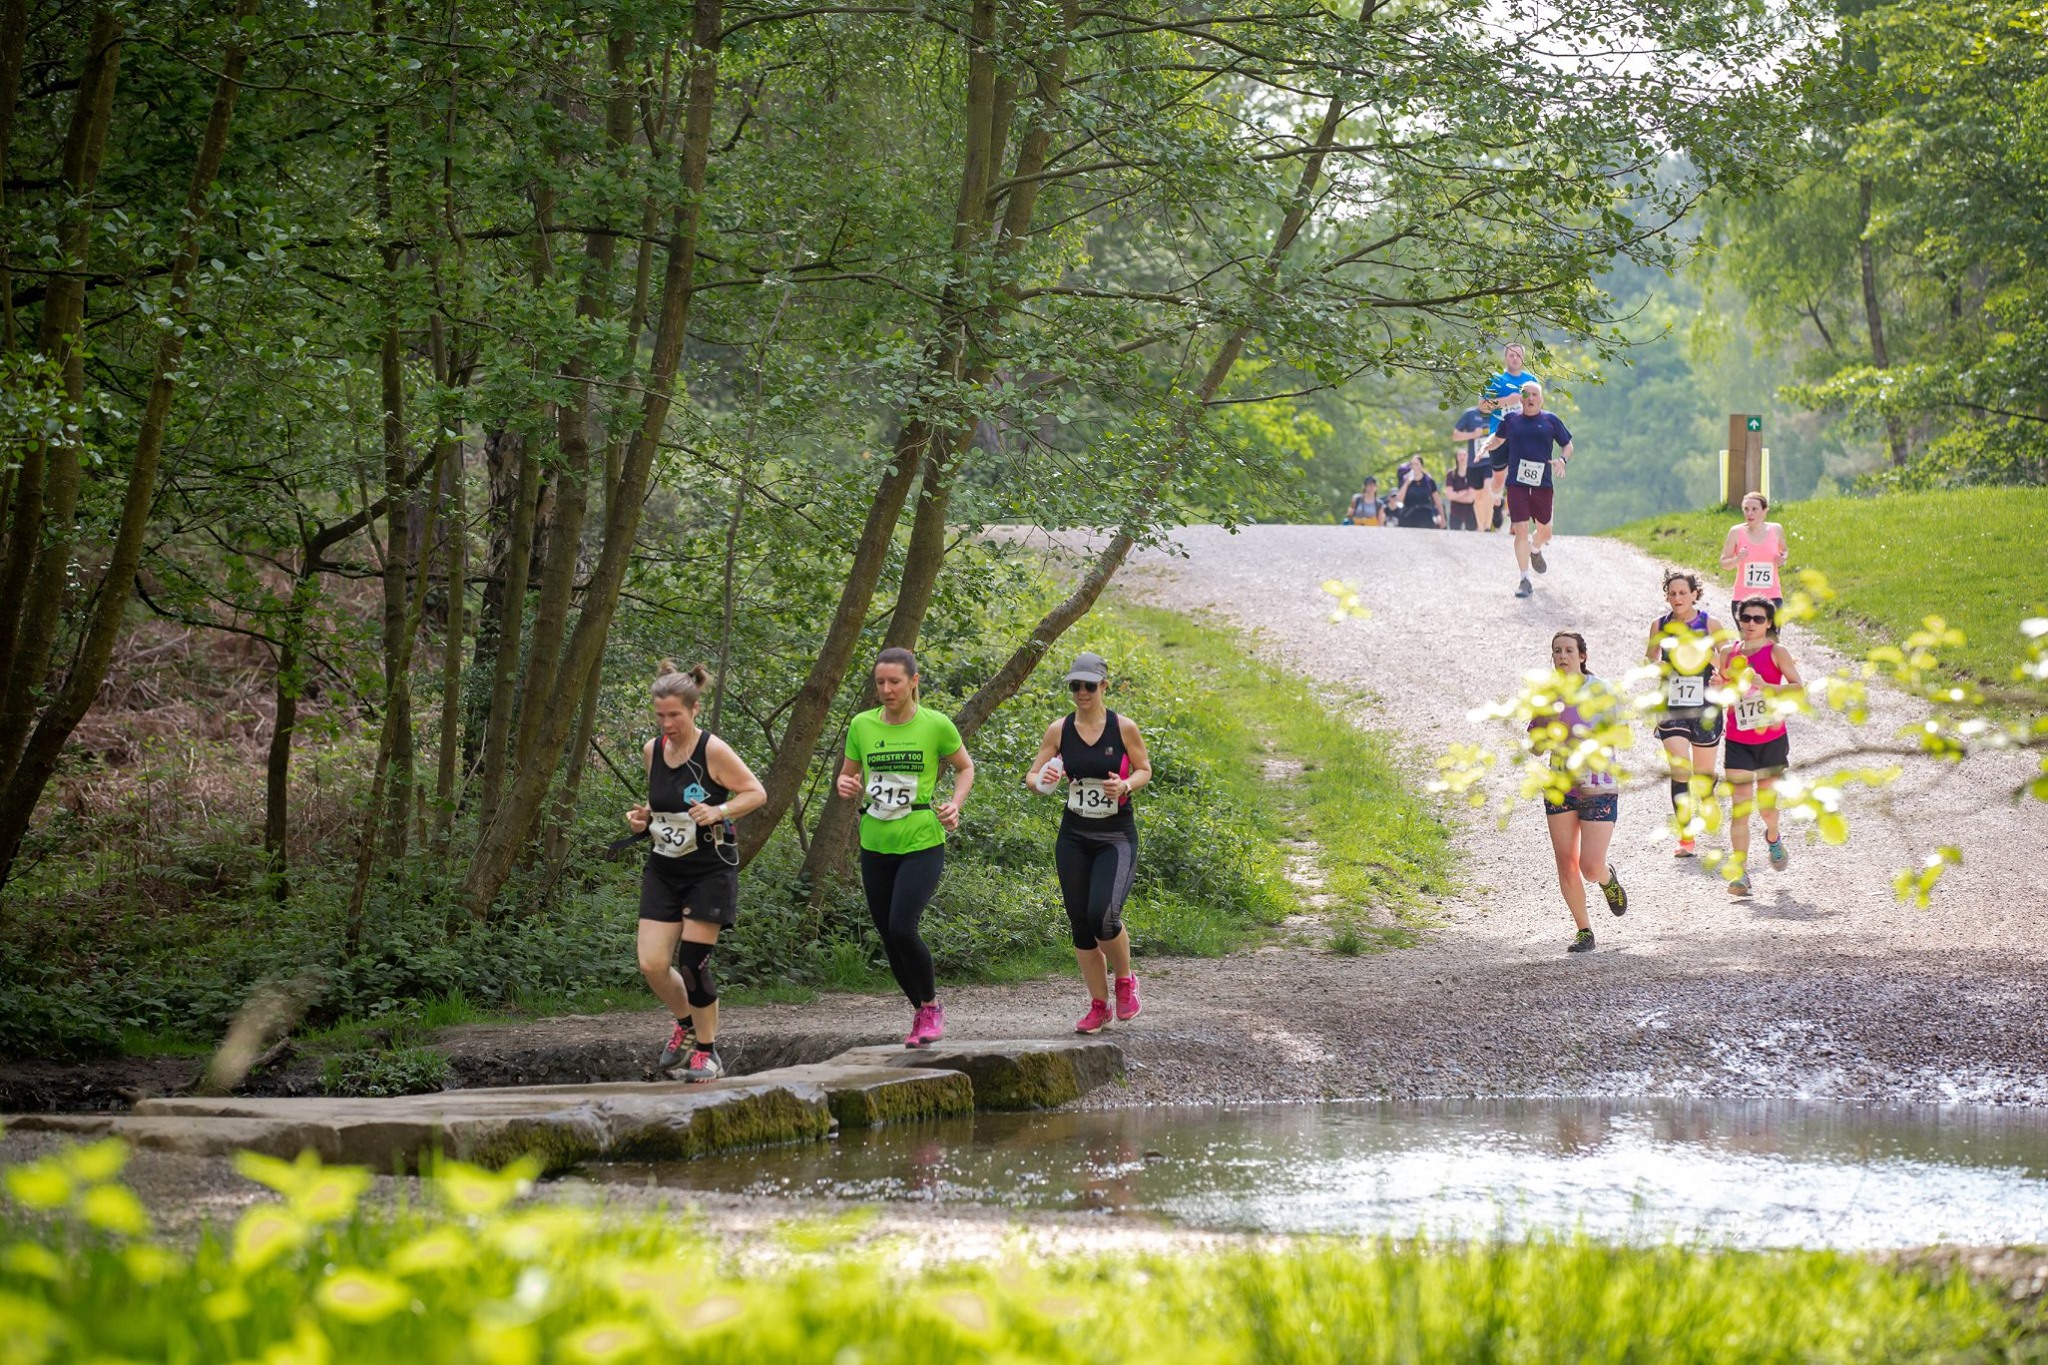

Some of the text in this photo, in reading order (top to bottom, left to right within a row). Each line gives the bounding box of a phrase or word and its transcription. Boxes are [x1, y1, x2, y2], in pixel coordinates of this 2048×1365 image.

[1524, 469, 1538, 480] 68
[1748, 570, 1770, 582] 175
[1678, 685, 1695, 698] 17
[1738, 700, 1767, 718] 178
[868, 753, 922, 763] FORESTRY 100
[870, 785, 910, 806] 215
[1076, 789, 1113, 808] 134
[661, 826, 686, 846] 35
